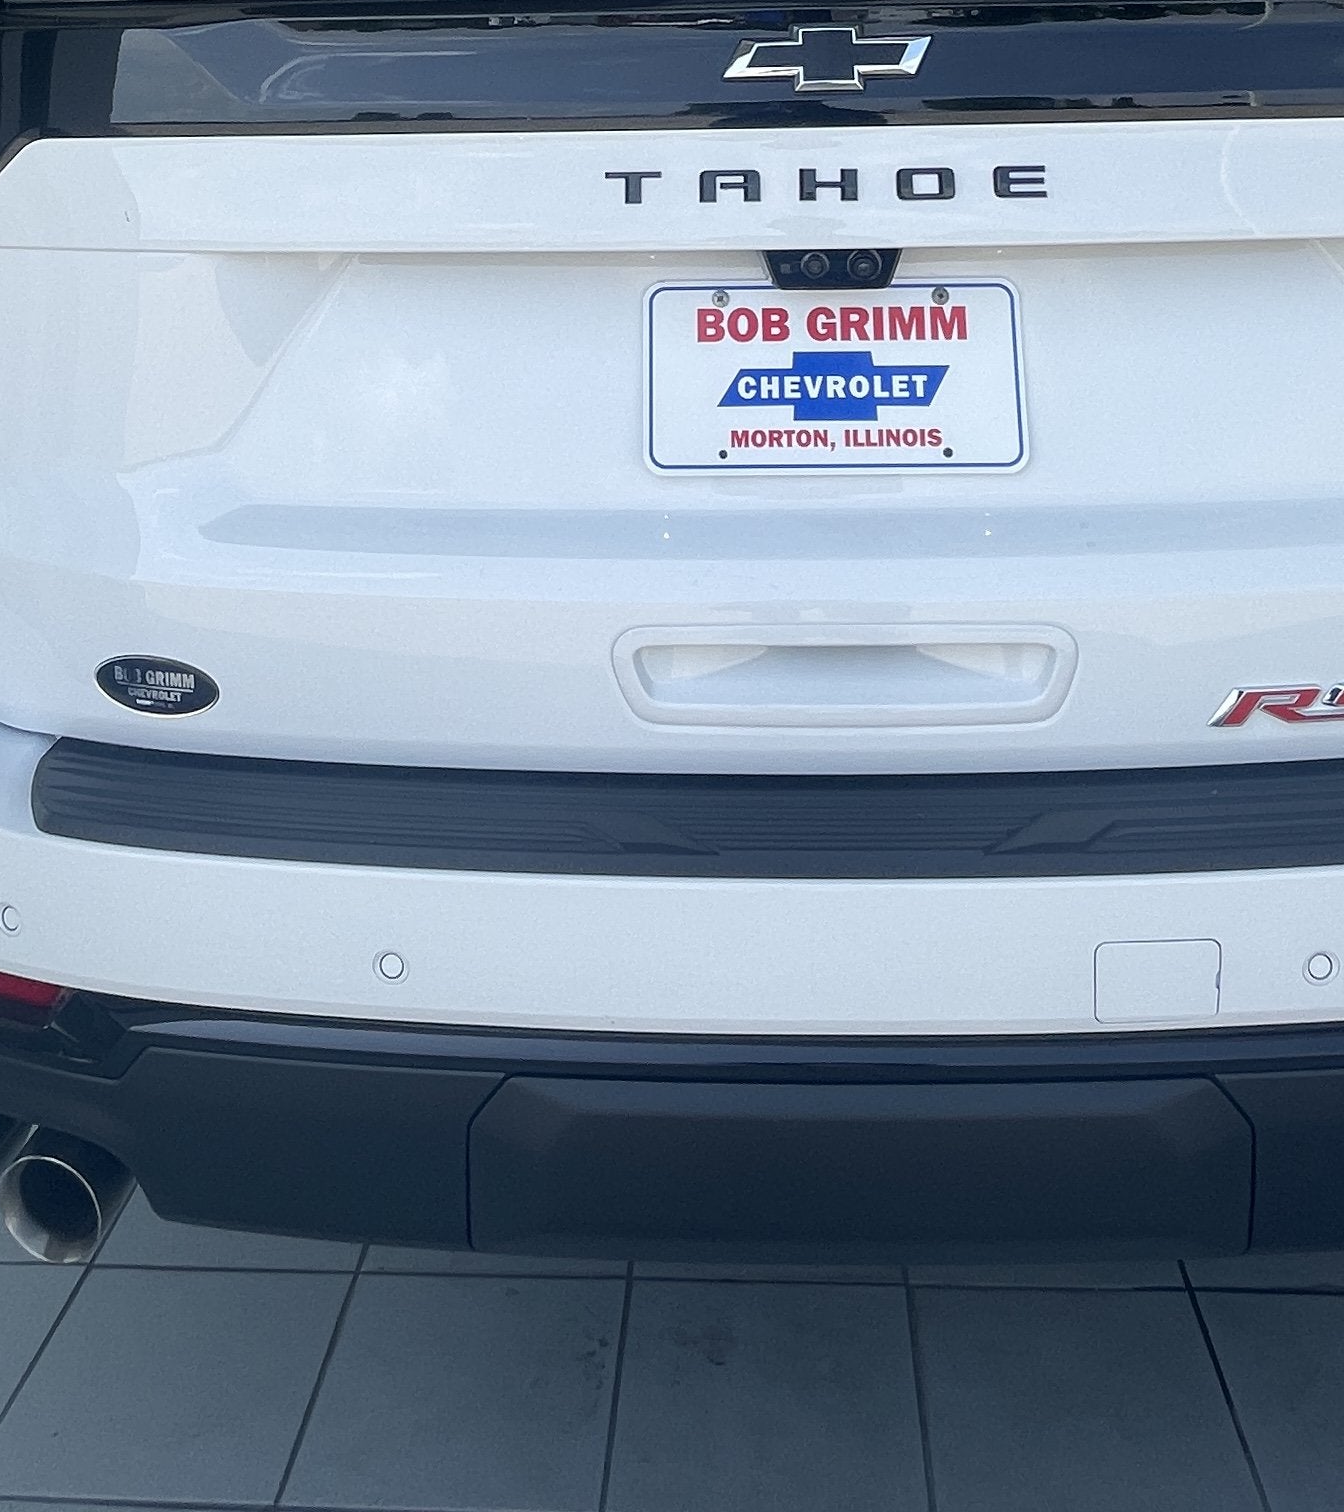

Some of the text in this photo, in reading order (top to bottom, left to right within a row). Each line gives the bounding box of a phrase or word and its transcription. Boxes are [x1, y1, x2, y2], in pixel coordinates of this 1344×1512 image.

[604, 165, 1049, 204] TAHOE
[696, 305, 969, 343] BOB GRIMM
[736, 372, 928, 400] CHEVROLET
[729, 427, 943, 452] MORTON, ILLINOIS
[145, 669, 195, 689] GRIMM
